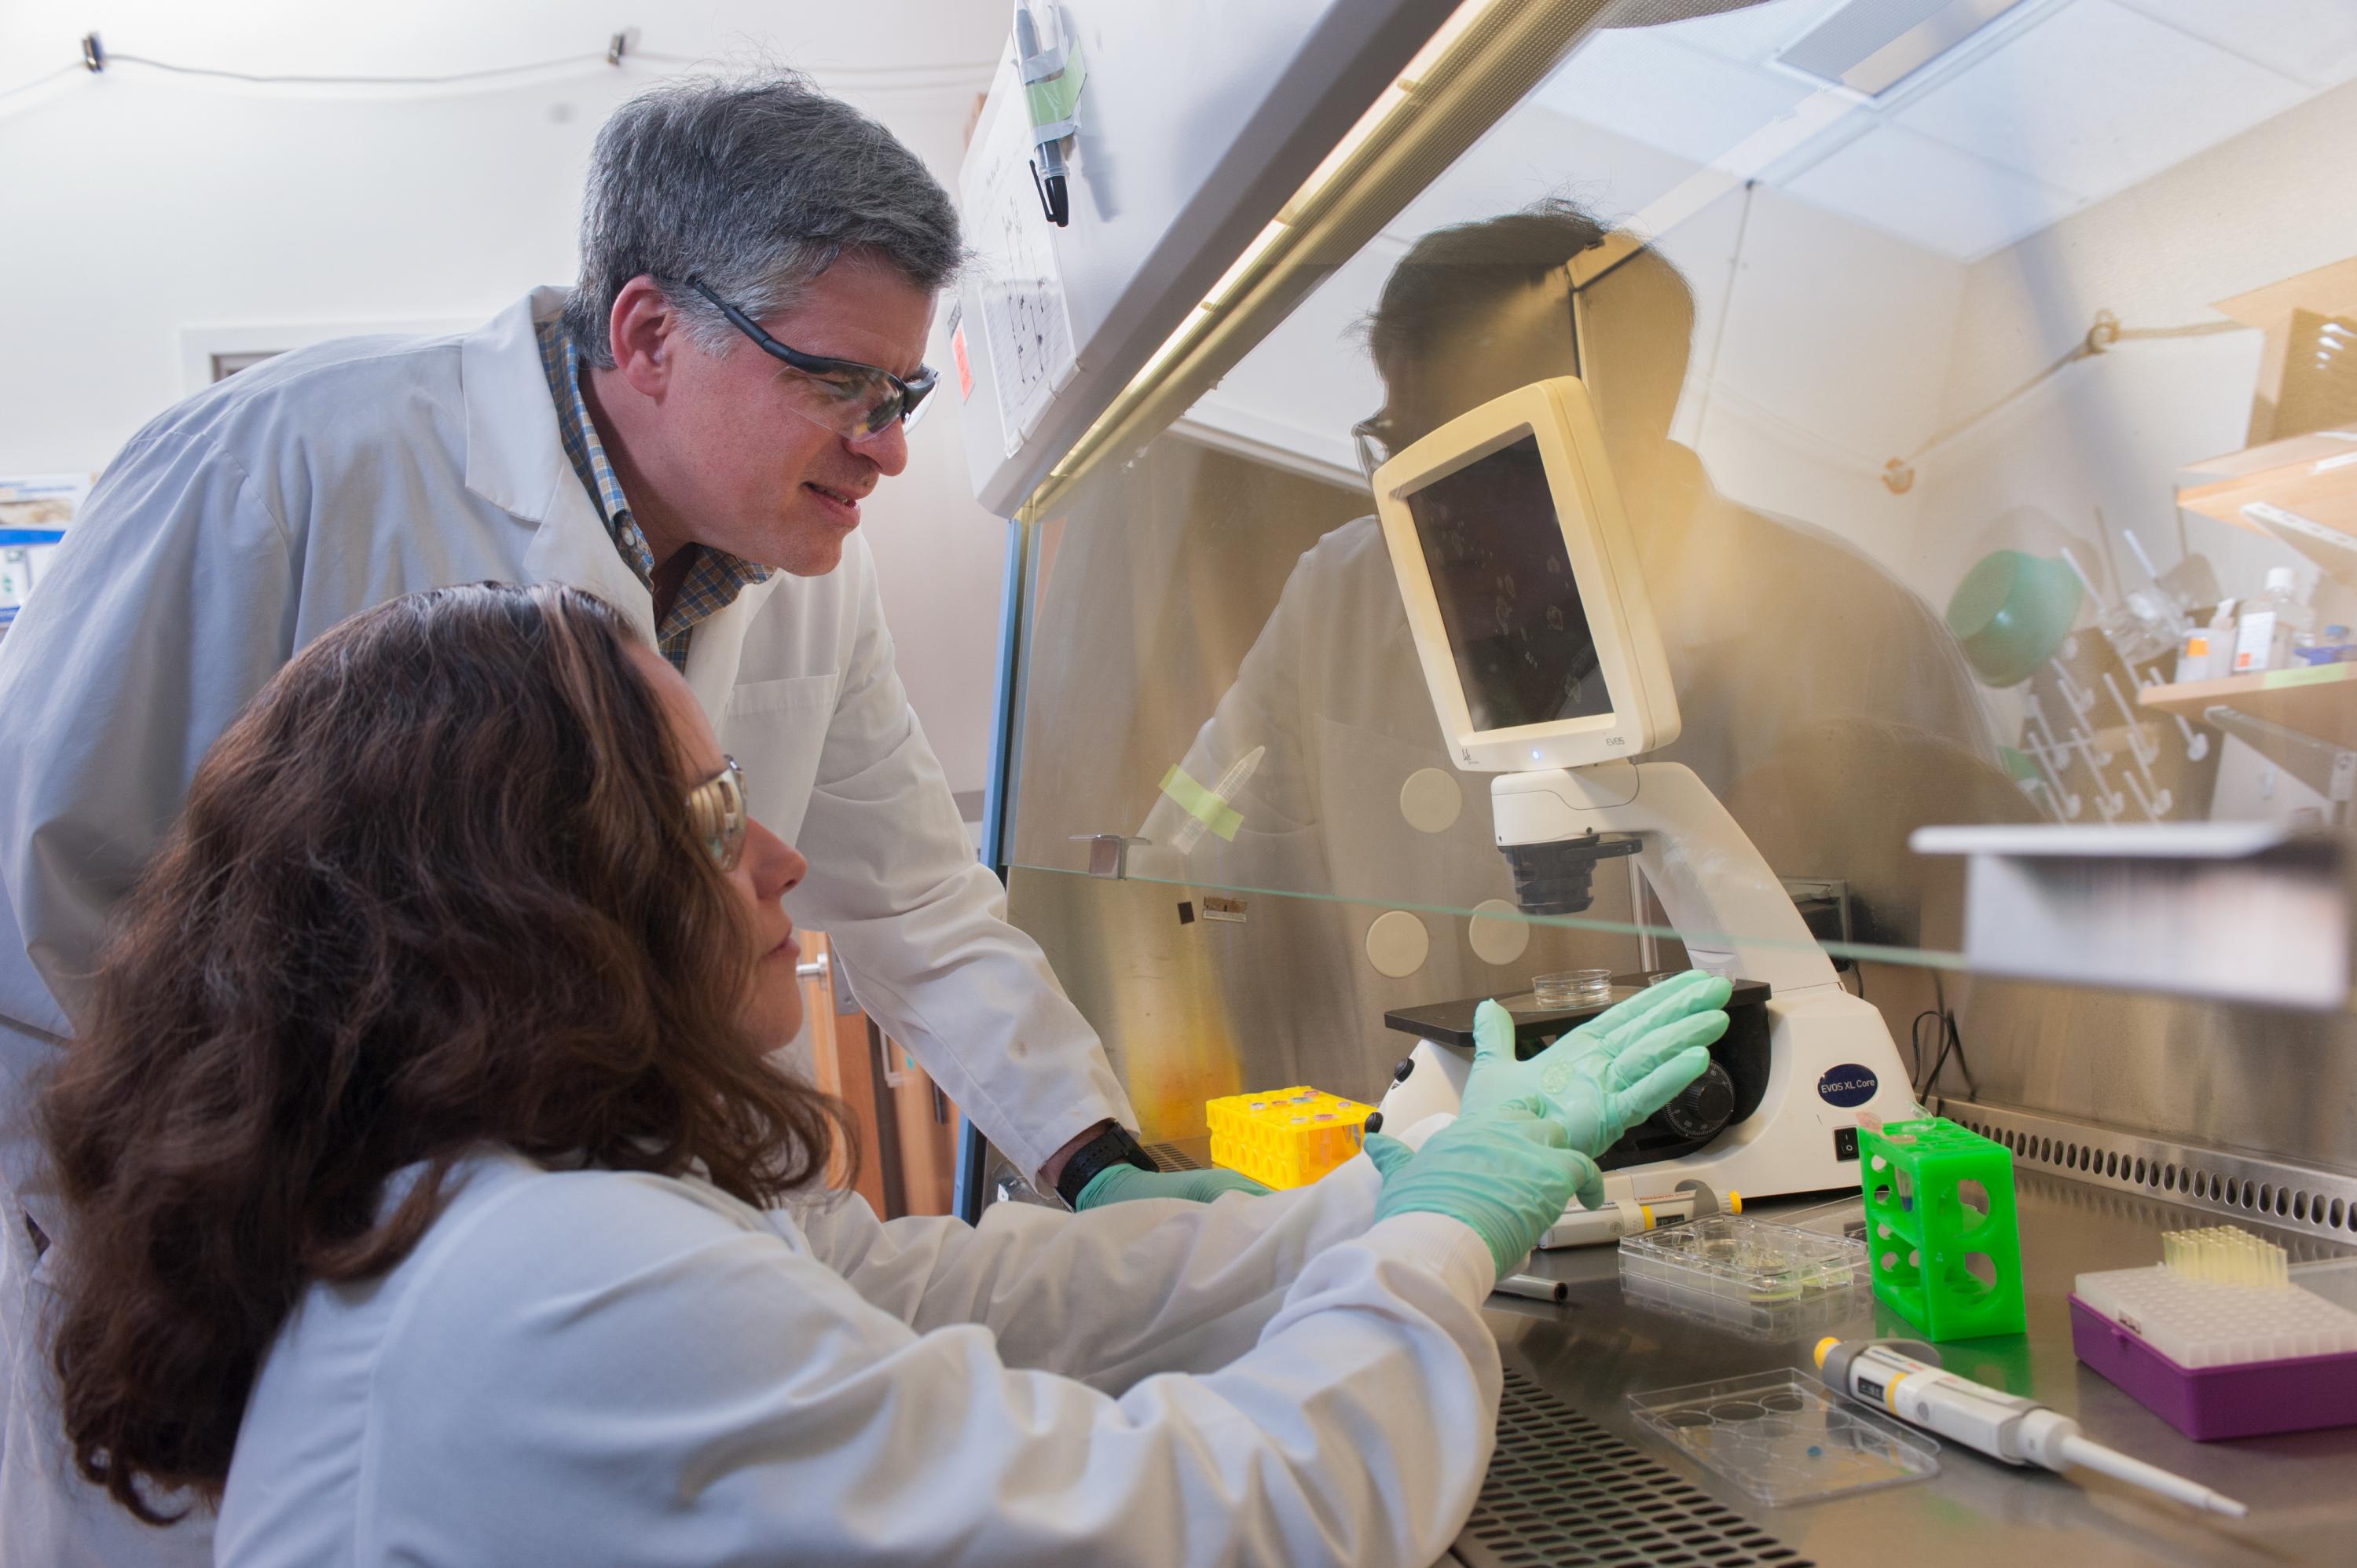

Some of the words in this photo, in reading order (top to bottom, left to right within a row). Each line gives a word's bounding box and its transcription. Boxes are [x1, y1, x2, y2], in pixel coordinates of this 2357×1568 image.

[1820, 1083, 1844, 1094] EVOS
[1844, 1081, 1856, 1090] XL
[1857, 1079, 1875, 1088] Core
